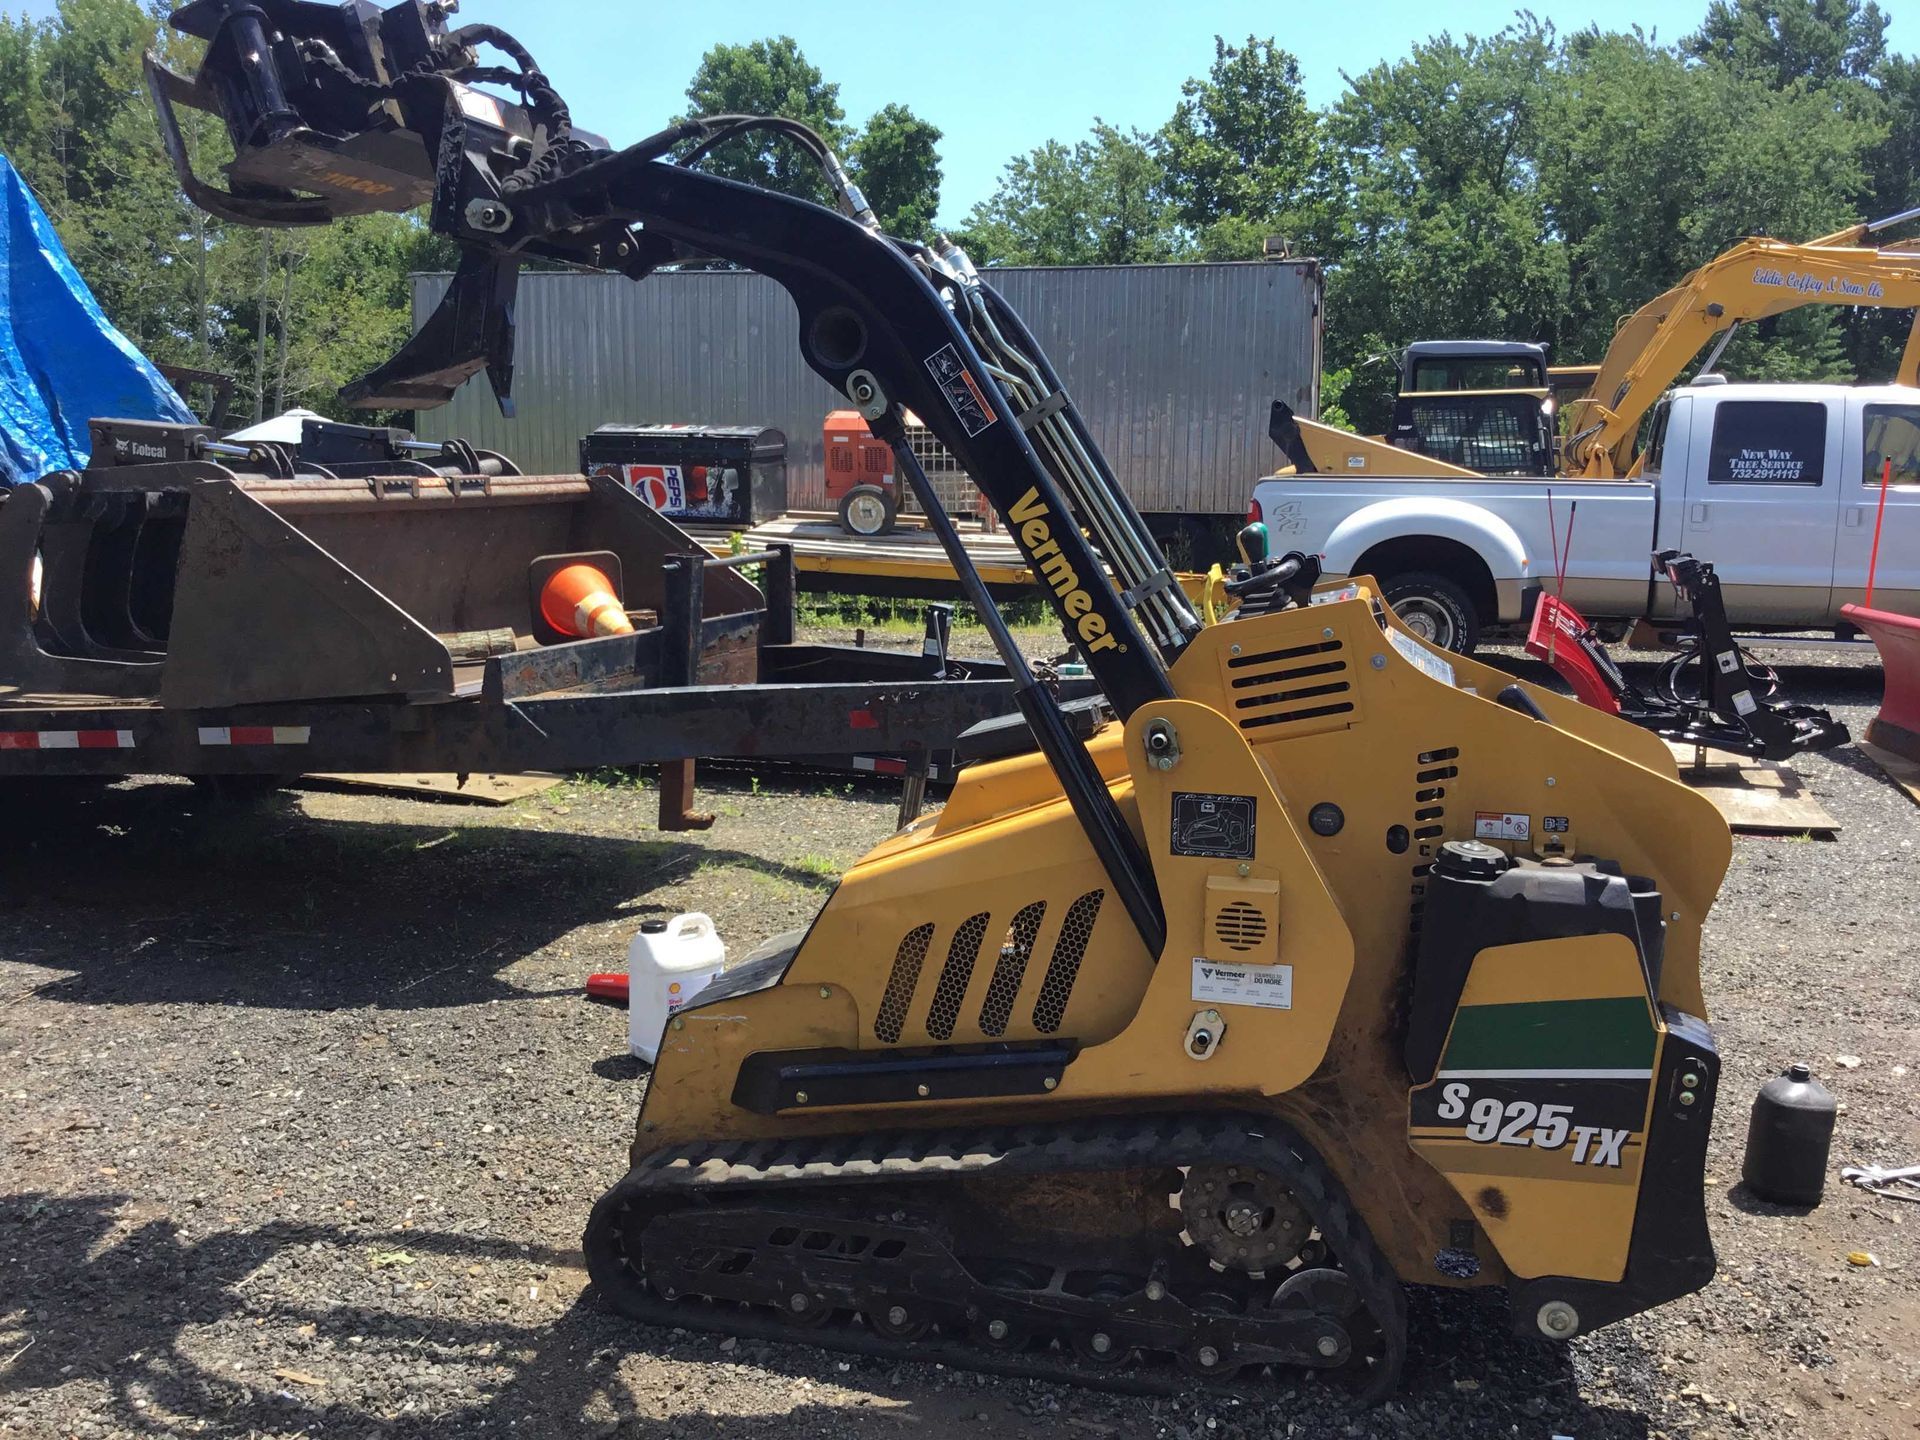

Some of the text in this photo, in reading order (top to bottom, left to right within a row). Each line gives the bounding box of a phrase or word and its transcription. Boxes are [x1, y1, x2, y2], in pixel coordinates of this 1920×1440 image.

[1753, 267, 1783, 285] Eddie
[1785, 272, 1823, 294] Coffey
[1839, 279, 1864, 295] Sons
[665, 467, 681, 507] PEPSI
[1731, 469, 1800, 479] 732-291-1113
[1007, 485, 1120, 654] Vermeer
[1214, 969, 1246, 979] Vermeer
